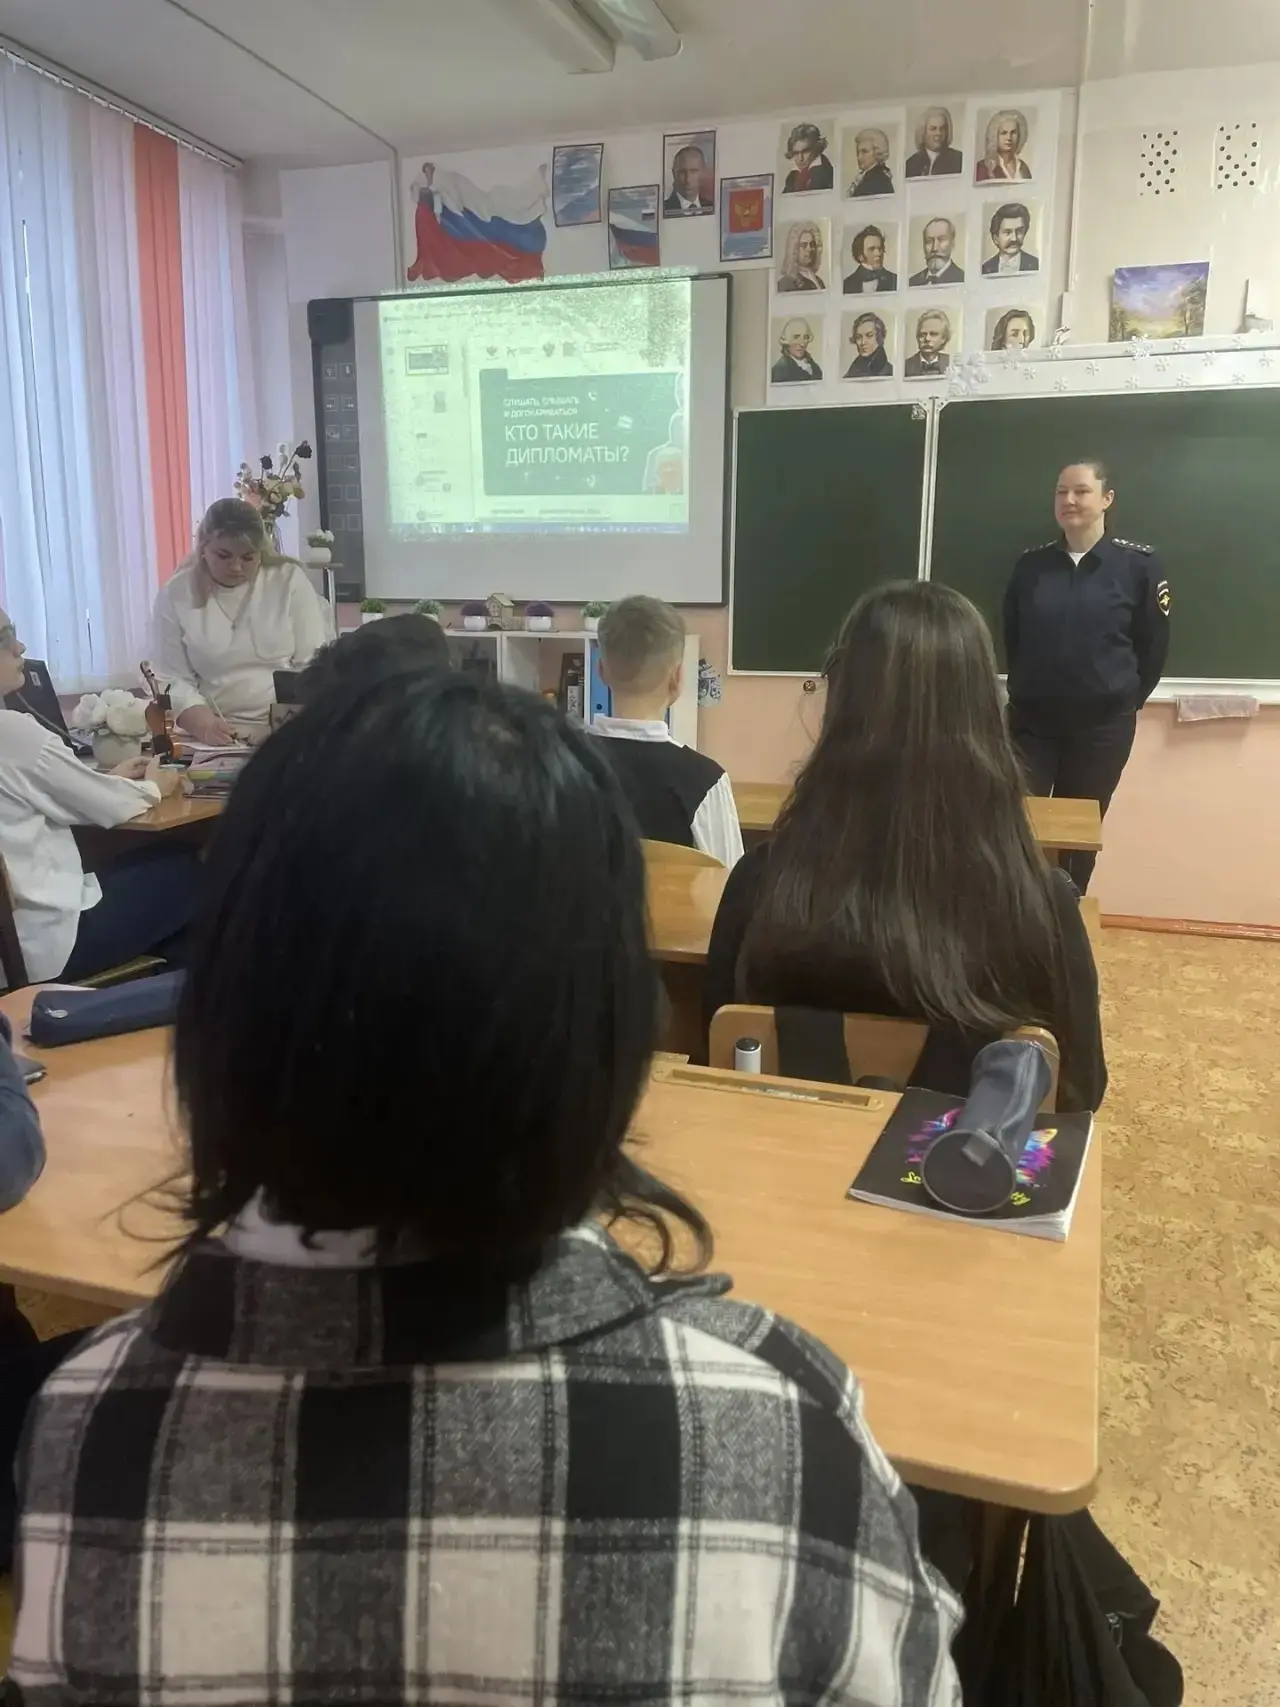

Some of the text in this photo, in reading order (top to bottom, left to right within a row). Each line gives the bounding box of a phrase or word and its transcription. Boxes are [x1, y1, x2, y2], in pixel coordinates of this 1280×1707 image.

[505, 422, 599, 441] КТО ТАКИЕ
[505, 445, 630, 468] ДИПЛОМАТЫ?
